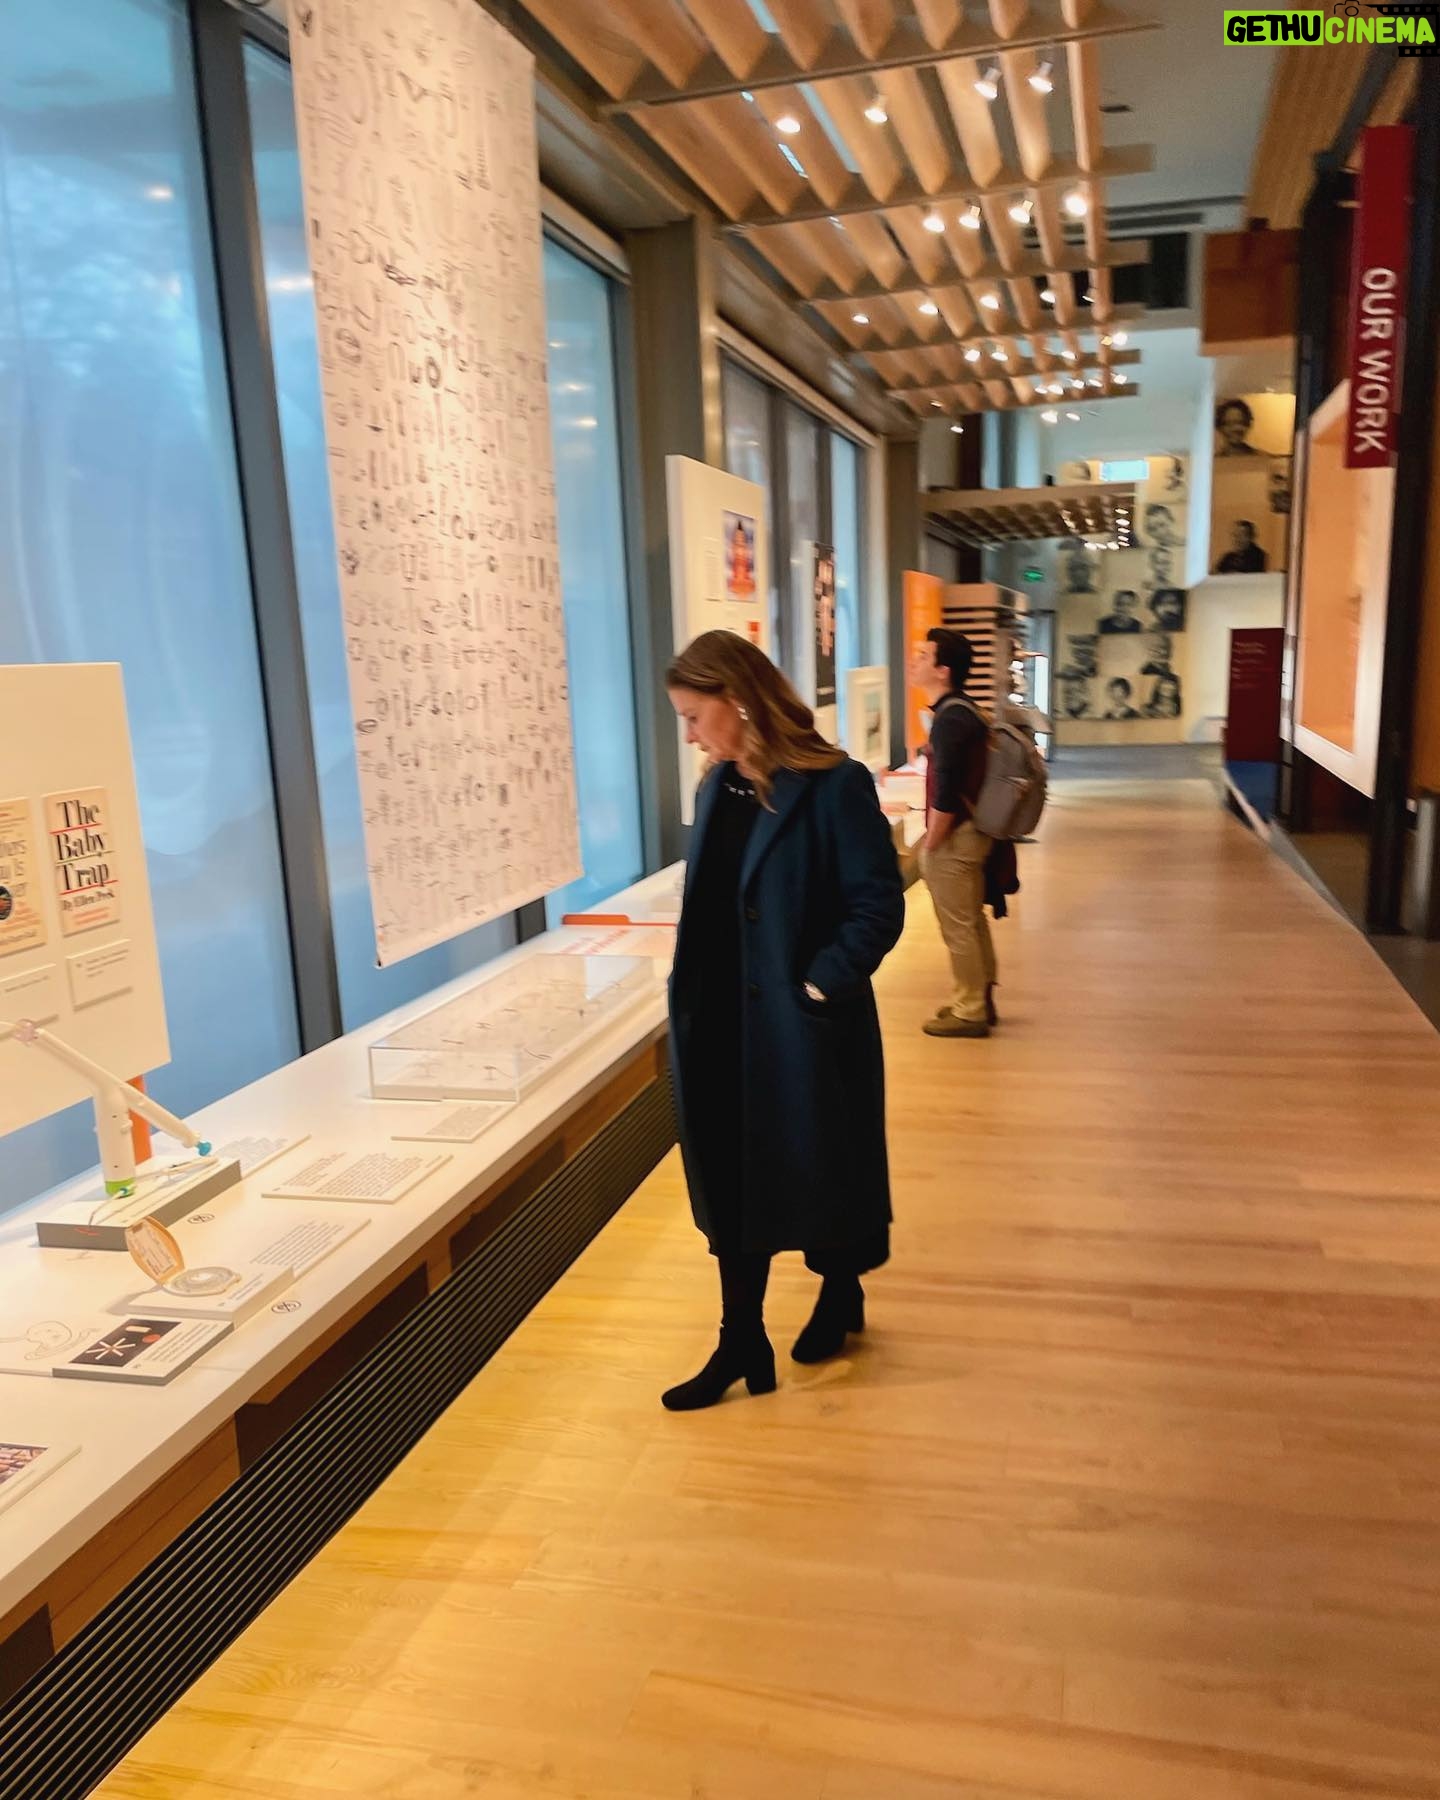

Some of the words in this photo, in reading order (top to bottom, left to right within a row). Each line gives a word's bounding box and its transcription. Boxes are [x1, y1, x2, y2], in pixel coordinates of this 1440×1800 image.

[1360, 267, 1398, 340] OUR
[1353, 350, 1392, 454] WORK
[56, 799, 101, 828] The
[56, 828, 107, 860] Baby
[55, 862, 110, 891] Trap
